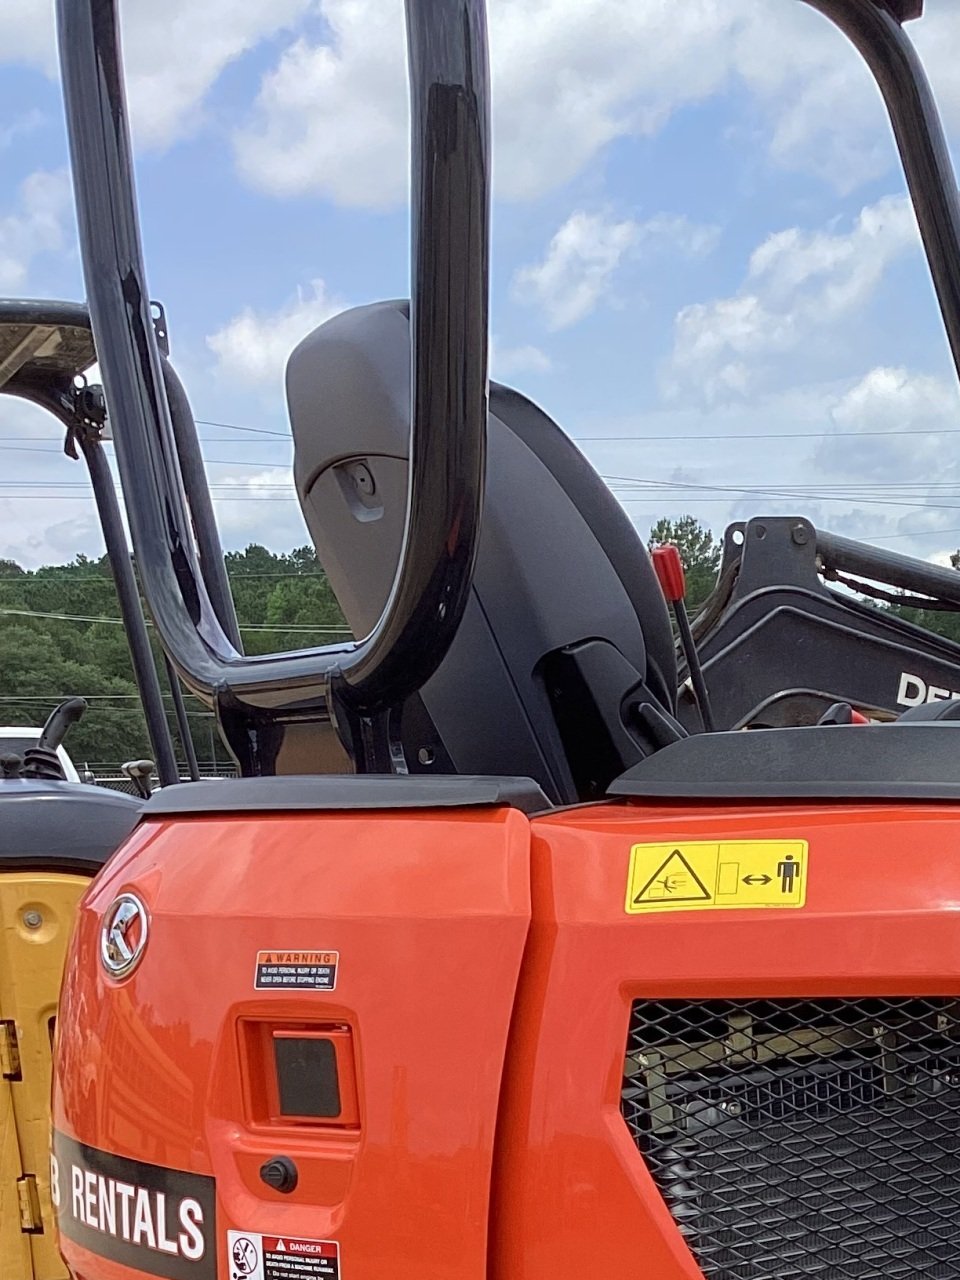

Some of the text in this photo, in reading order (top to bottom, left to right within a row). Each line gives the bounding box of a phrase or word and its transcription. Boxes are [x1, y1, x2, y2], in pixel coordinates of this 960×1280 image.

[276, 954, 331, 964] WARNING
[71, 1164, 205, 1261] RENTALS
[289, 1243, 322, 1254] DANGER
